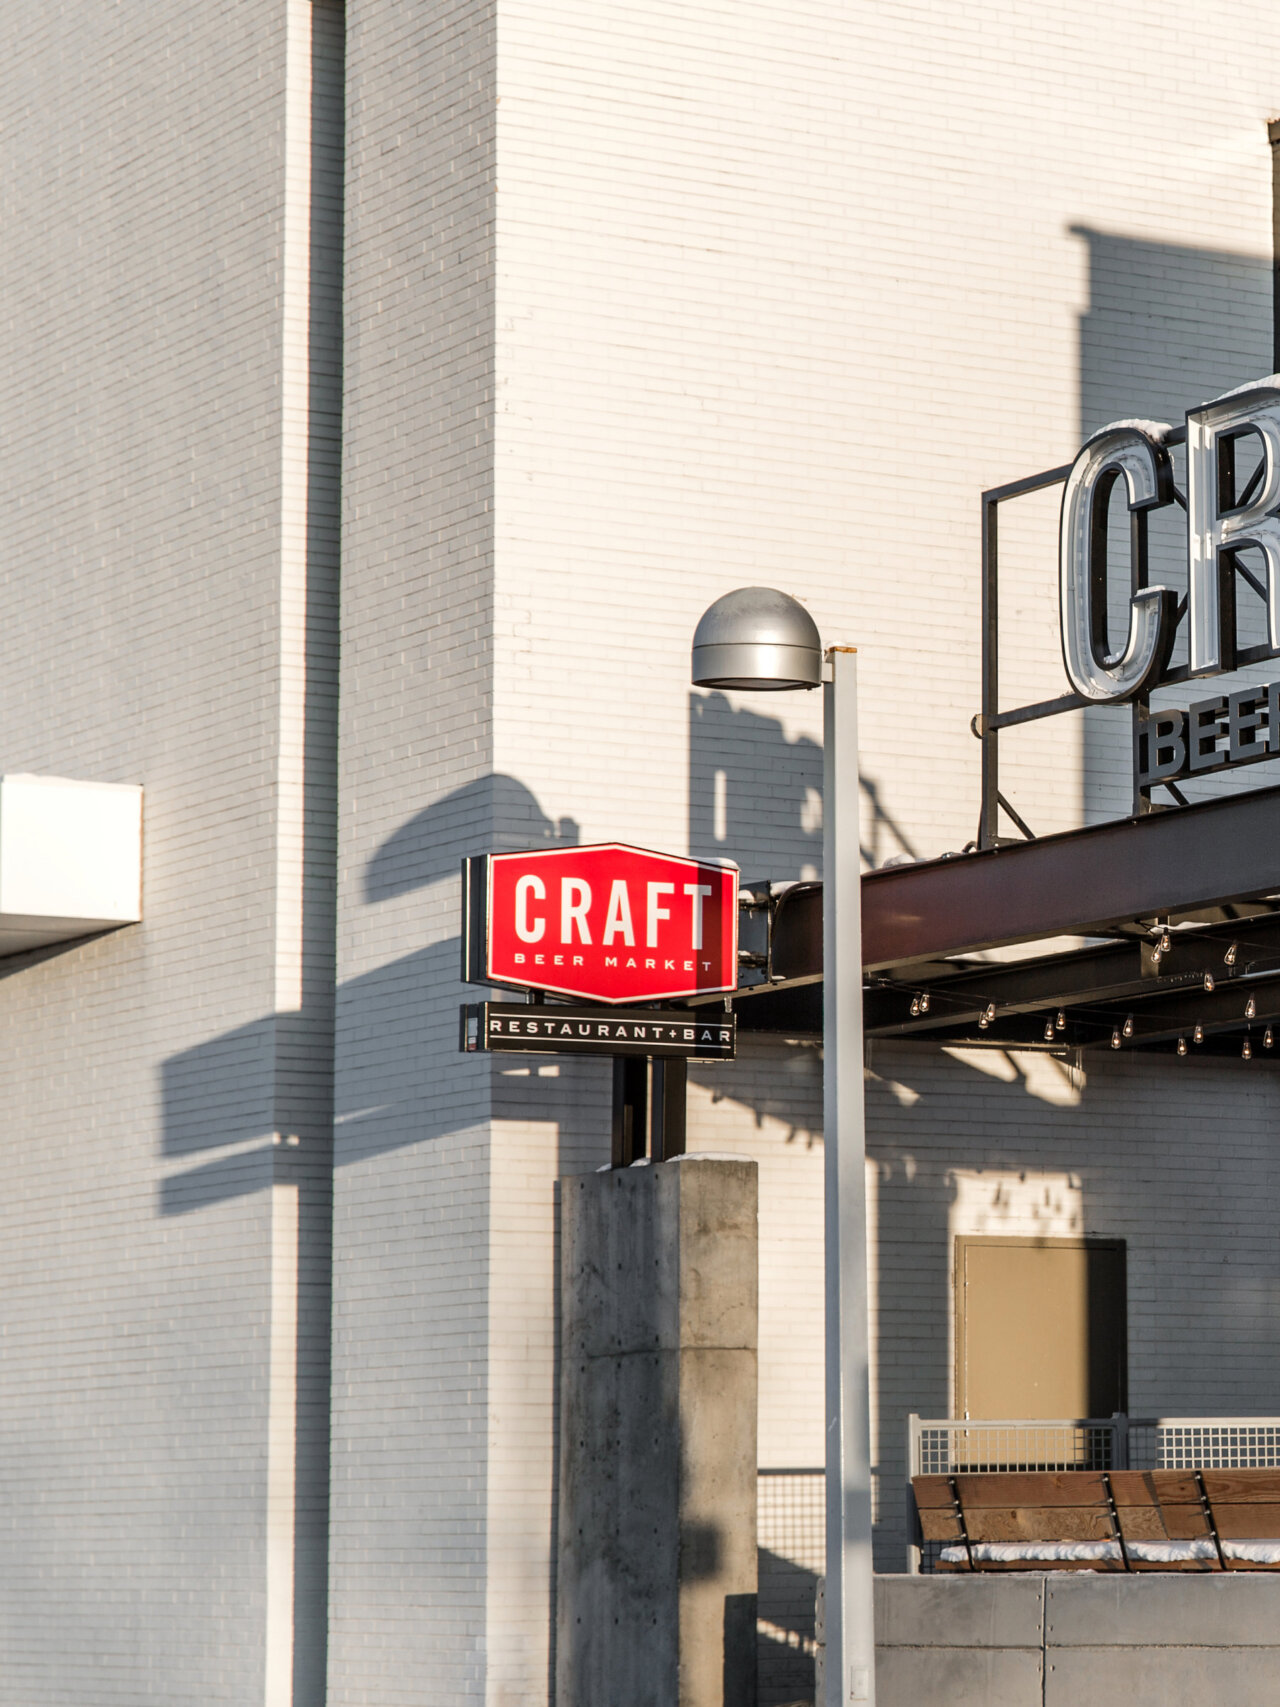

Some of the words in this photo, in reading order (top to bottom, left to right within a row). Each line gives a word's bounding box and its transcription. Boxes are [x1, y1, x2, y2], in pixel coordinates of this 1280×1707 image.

[514, 874, 712, 950] CRAFT
[514, 952, 584, 966] BEER
[604, 956, 712, 972] MARKET
